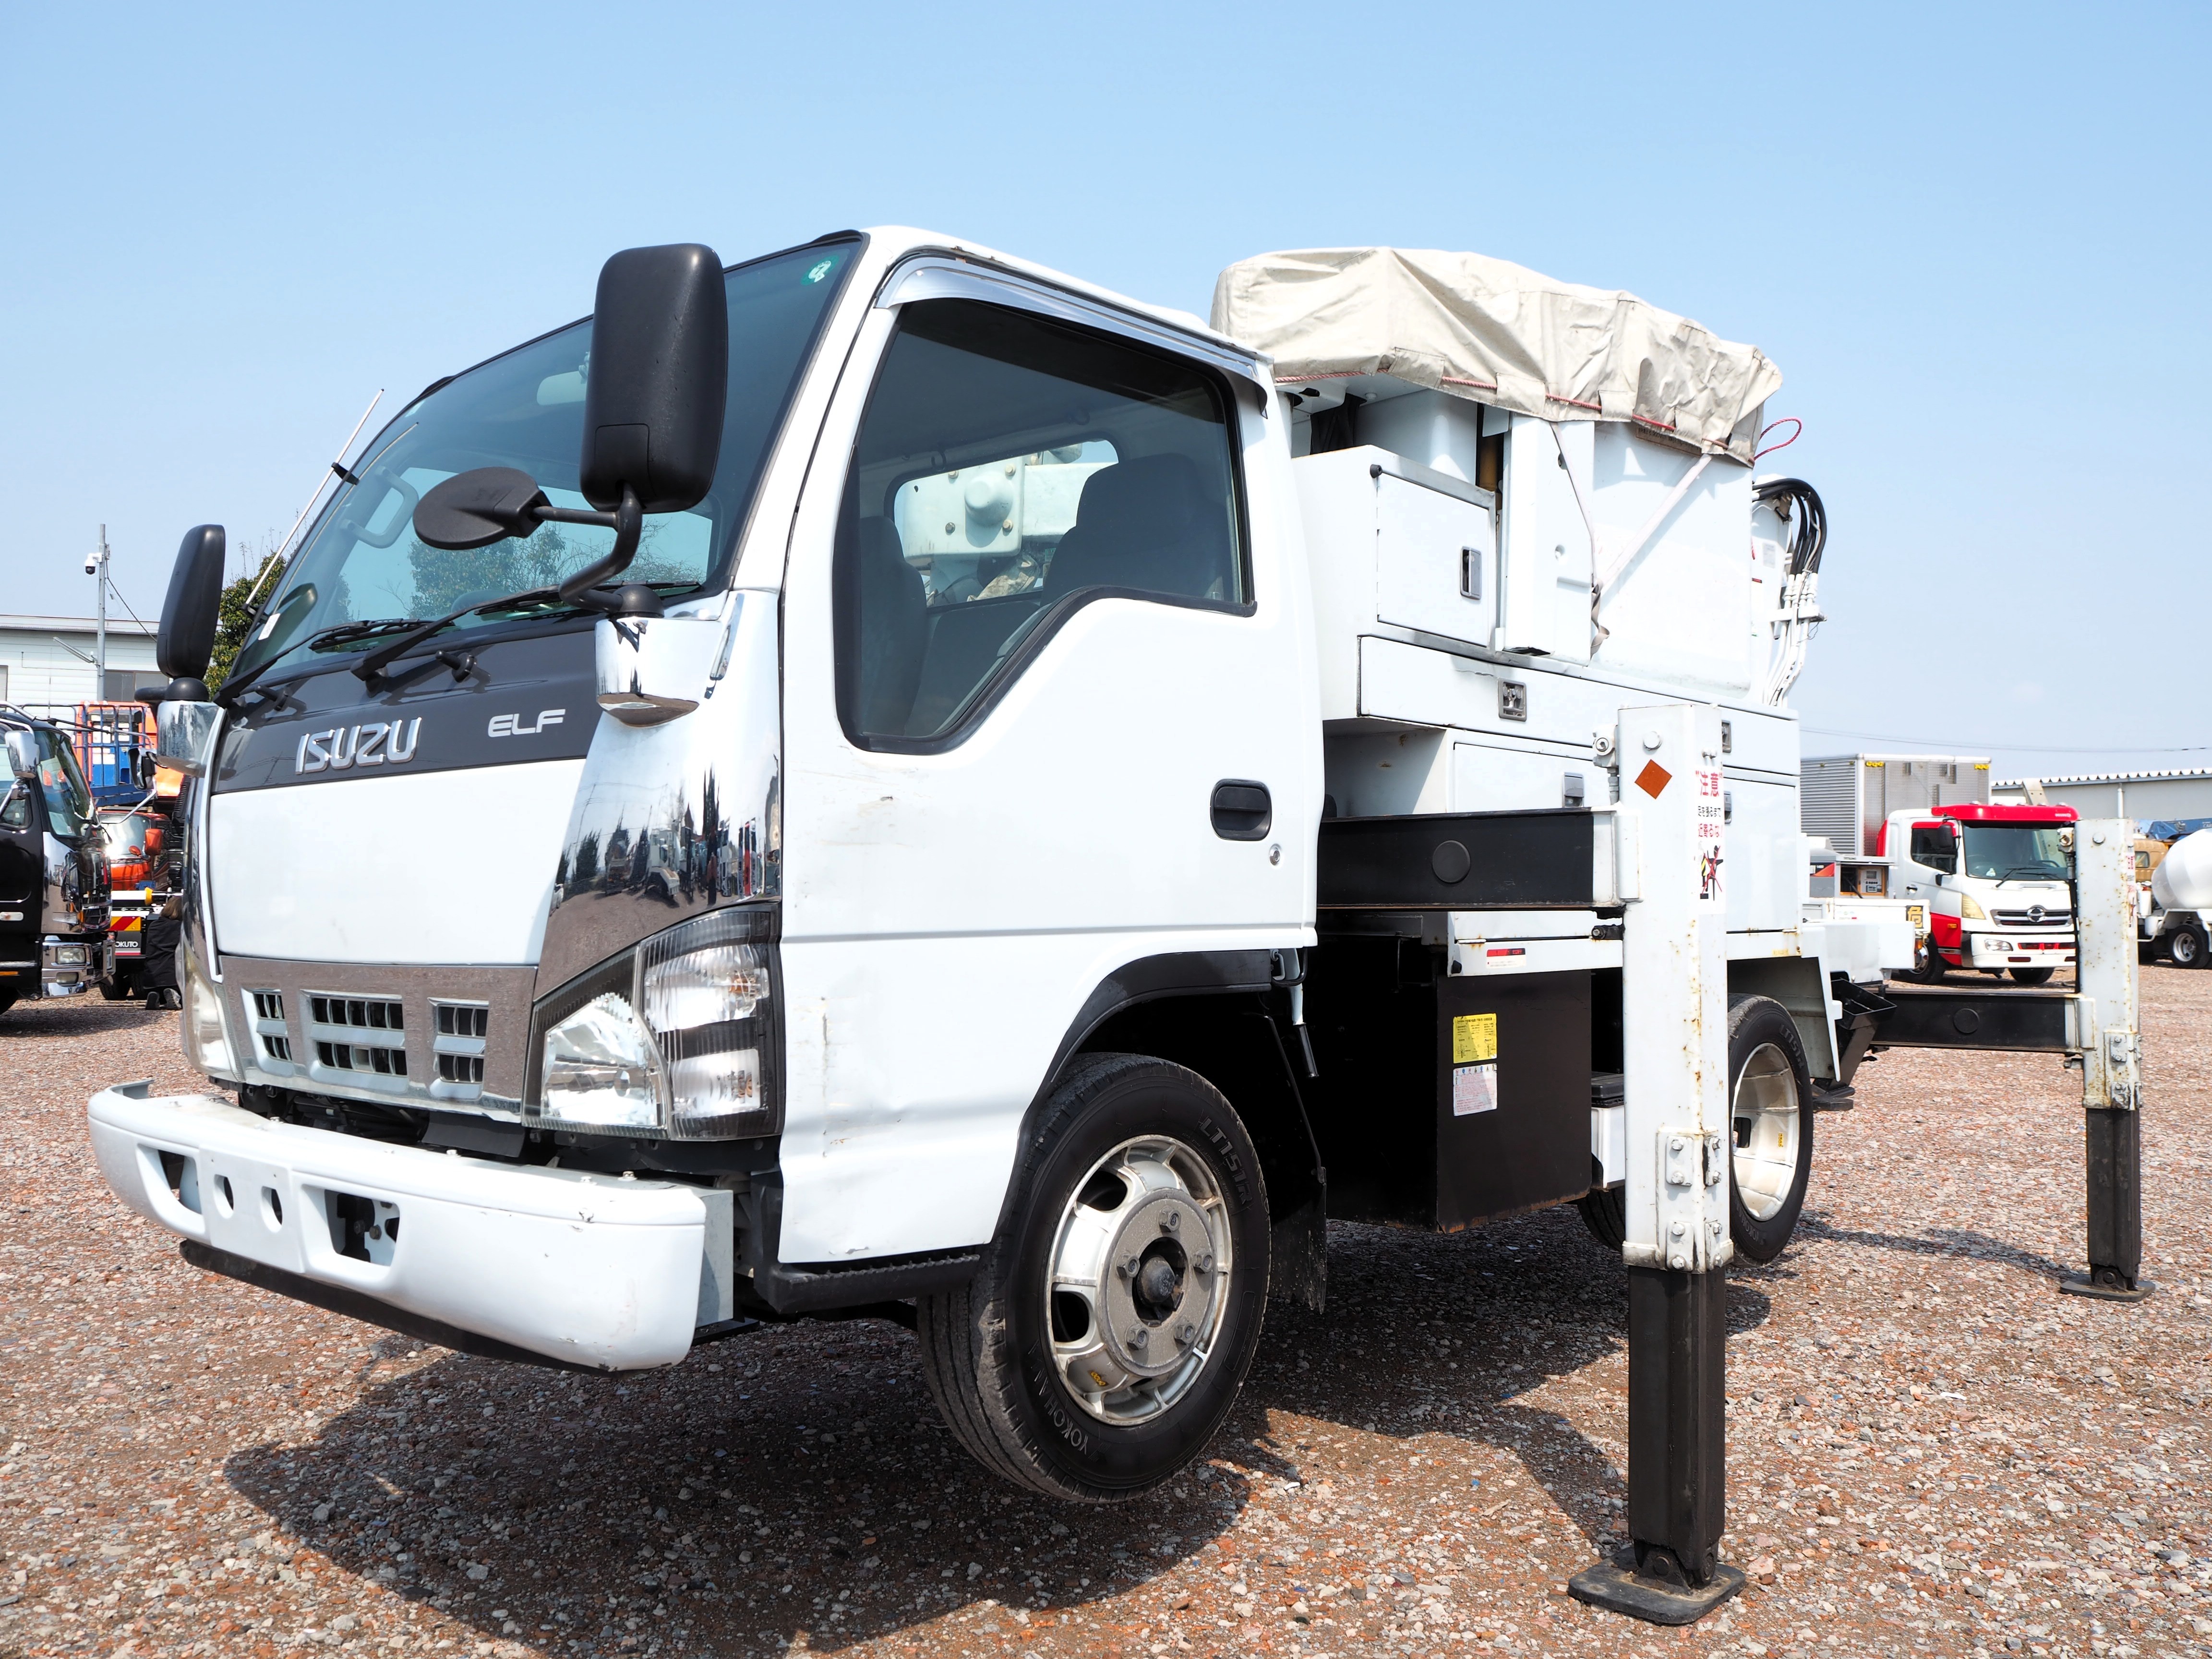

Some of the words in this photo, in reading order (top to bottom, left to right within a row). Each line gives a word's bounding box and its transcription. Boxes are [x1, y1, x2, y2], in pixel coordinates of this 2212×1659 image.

[295, 716, 422, 775] ISUZU
[487, 709, 566, 738] ELF
[1199, 1116, 1252, 1205] LT151R
